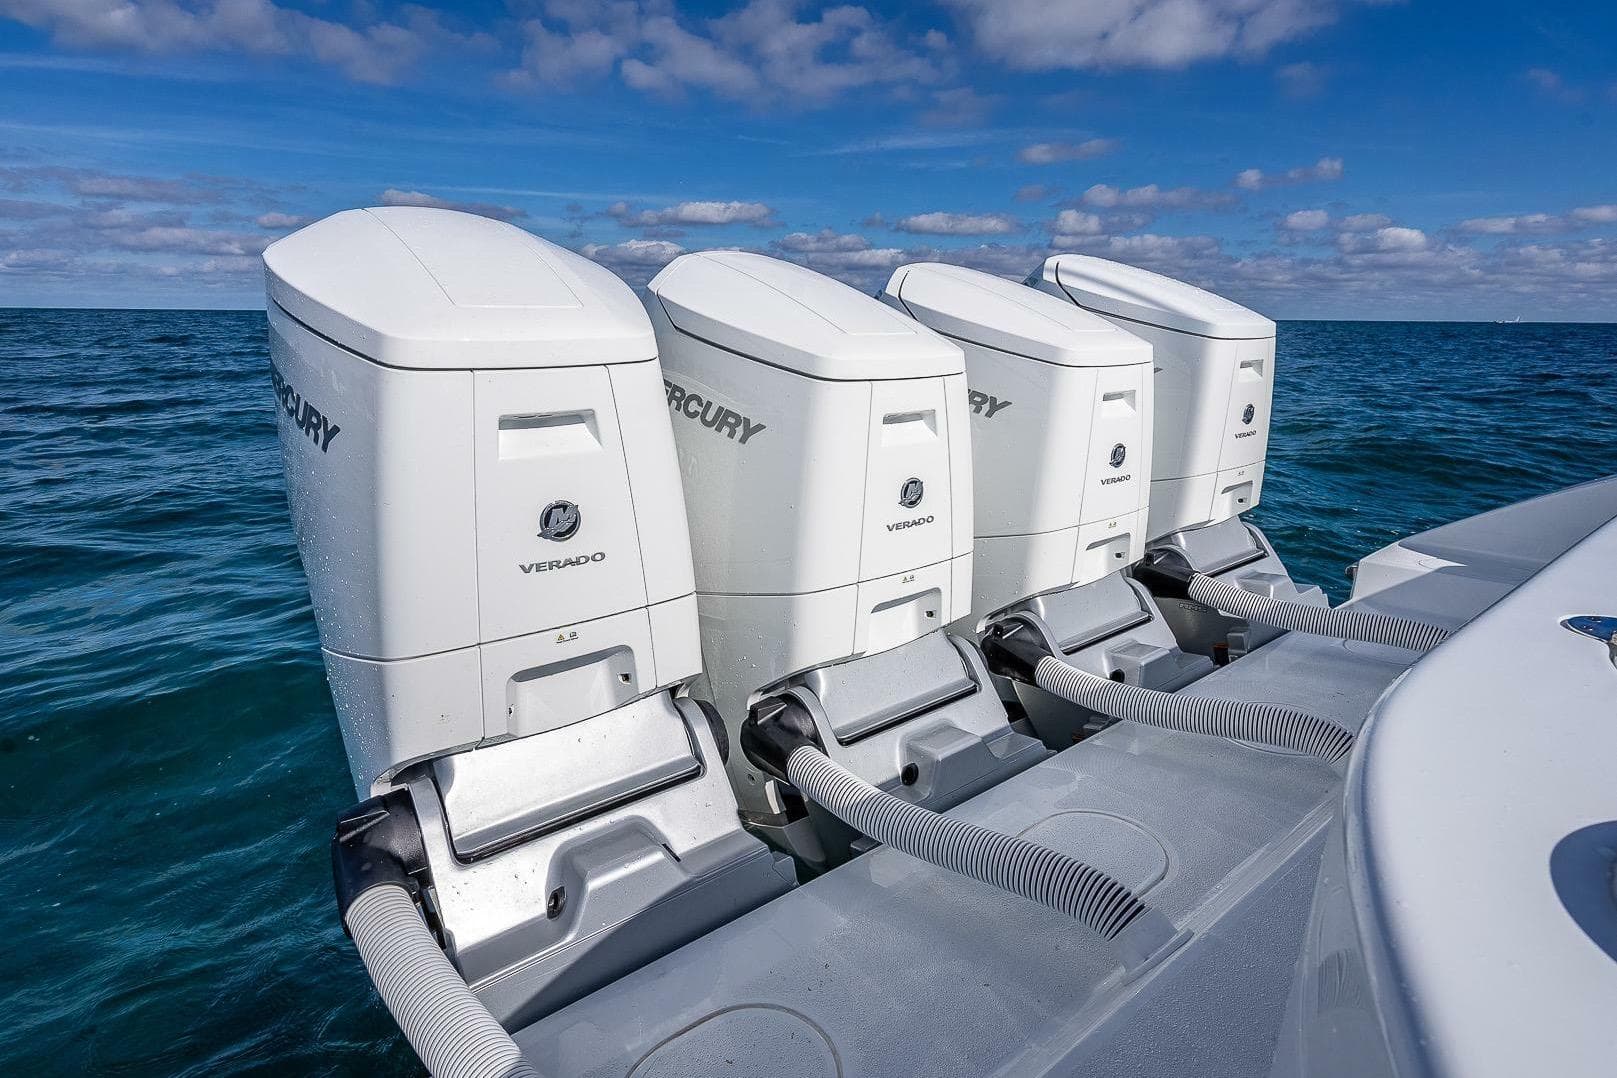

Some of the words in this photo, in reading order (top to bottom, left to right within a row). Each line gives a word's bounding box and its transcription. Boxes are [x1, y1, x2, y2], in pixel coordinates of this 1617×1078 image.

[967, 388, 1013, 419] RY
[1100, 474, 1132, 486] VERADO
[886, 515, 935, 531] VERADO
[518, 551, 606, 574] VERADO
